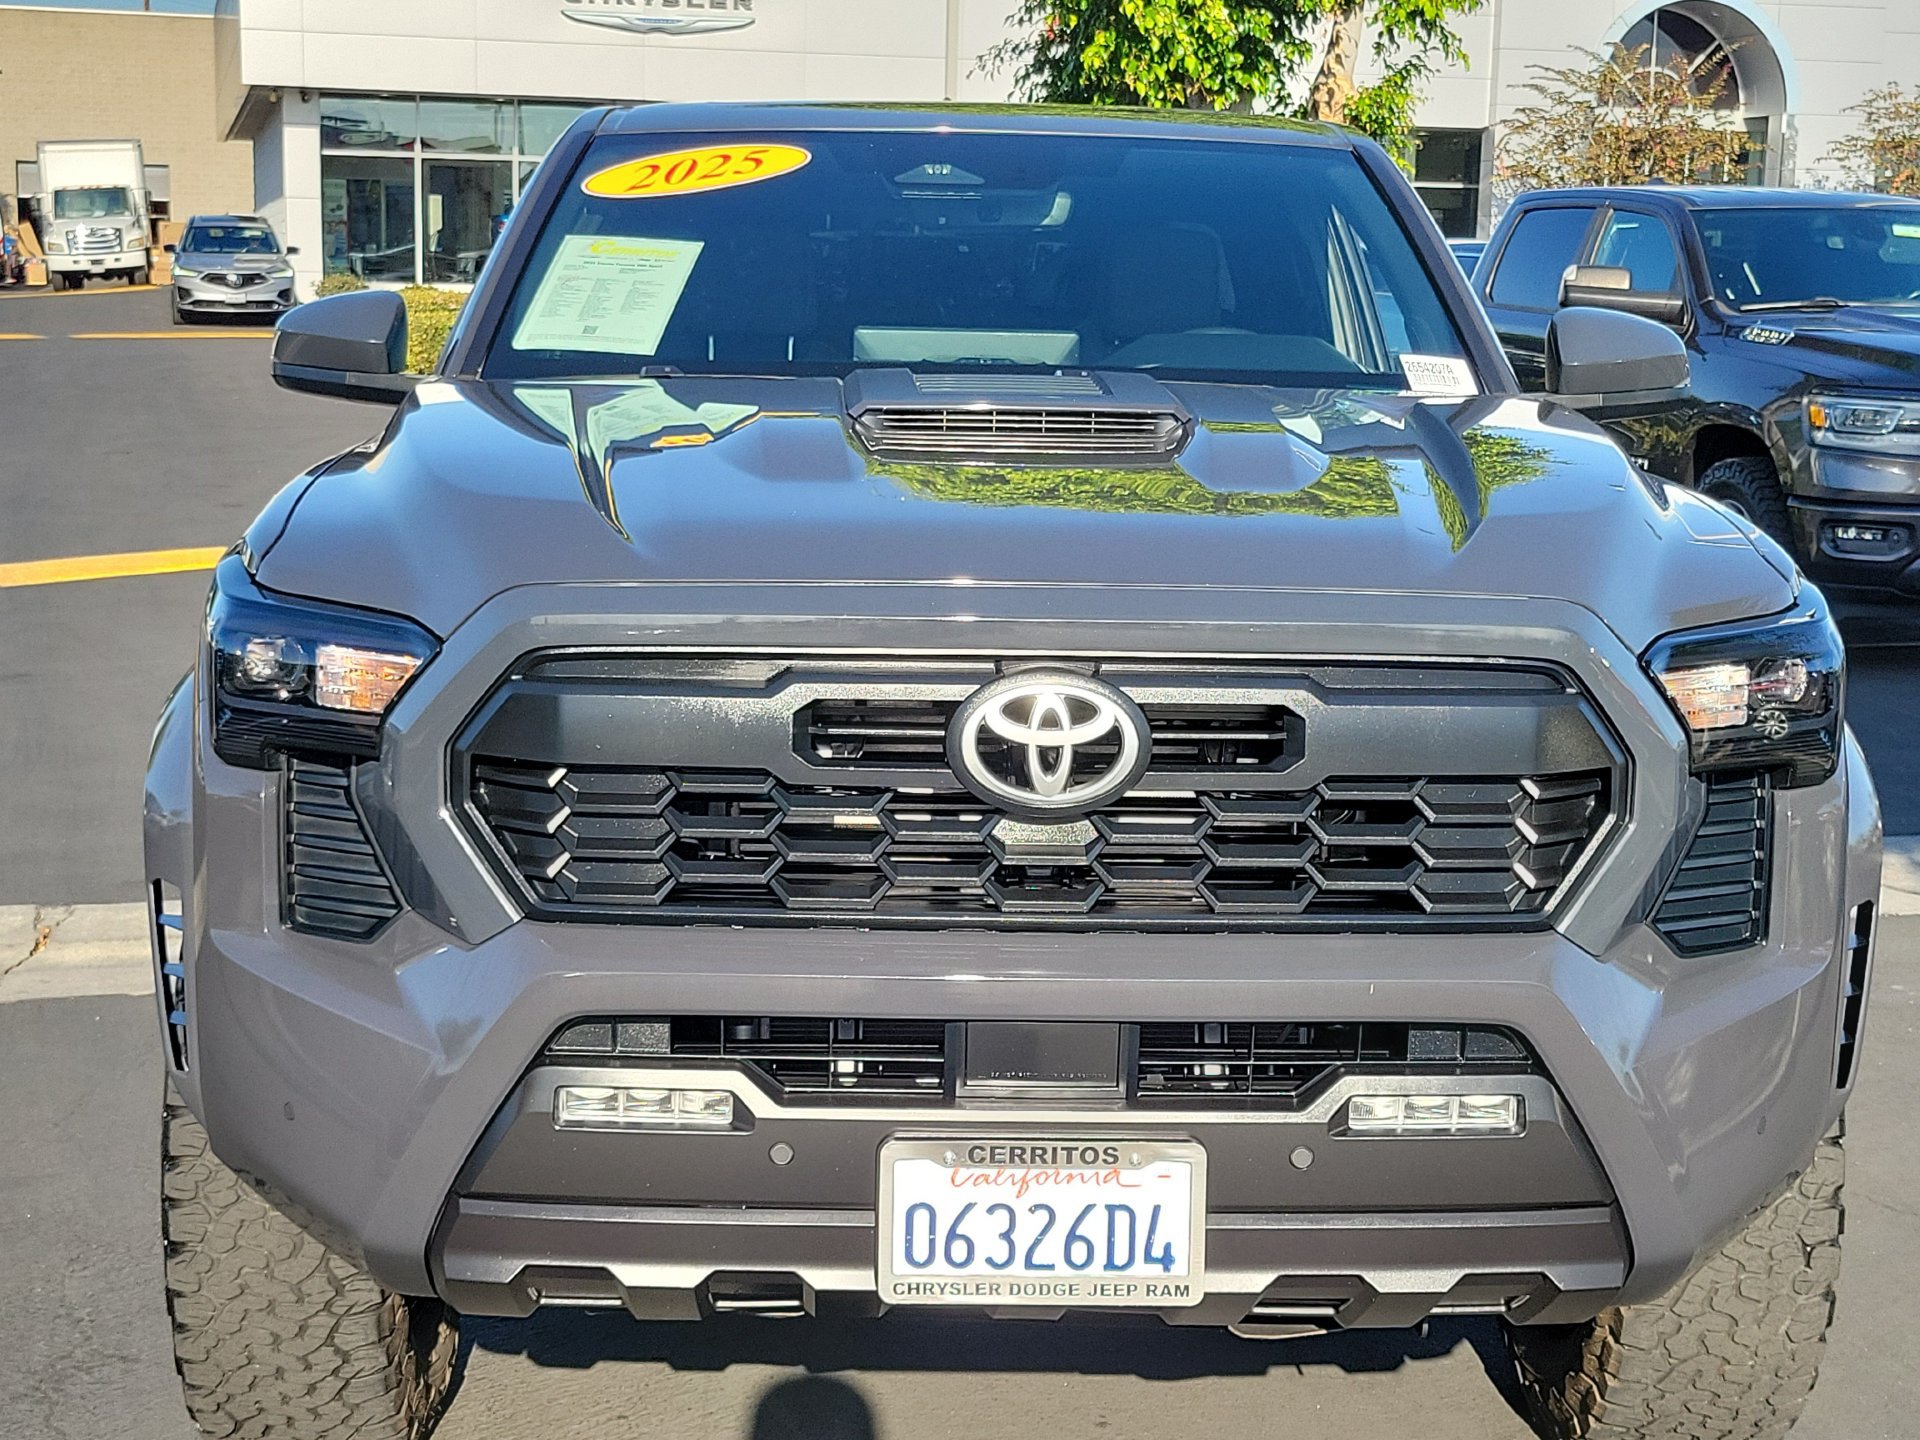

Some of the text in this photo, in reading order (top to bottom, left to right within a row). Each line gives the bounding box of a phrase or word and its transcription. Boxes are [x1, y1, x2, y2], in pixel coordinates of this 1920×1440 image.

[624, 149, 770, 192] 2025
[967, 1145, 1120, 1166] CERRITOS
[951, 1166, 1142, 1199] California
[904, 1202, 1176, 1273] 06326D4
[892, 1282, 1190, 1298] CHRYSLER DODGE JEEP RAM
